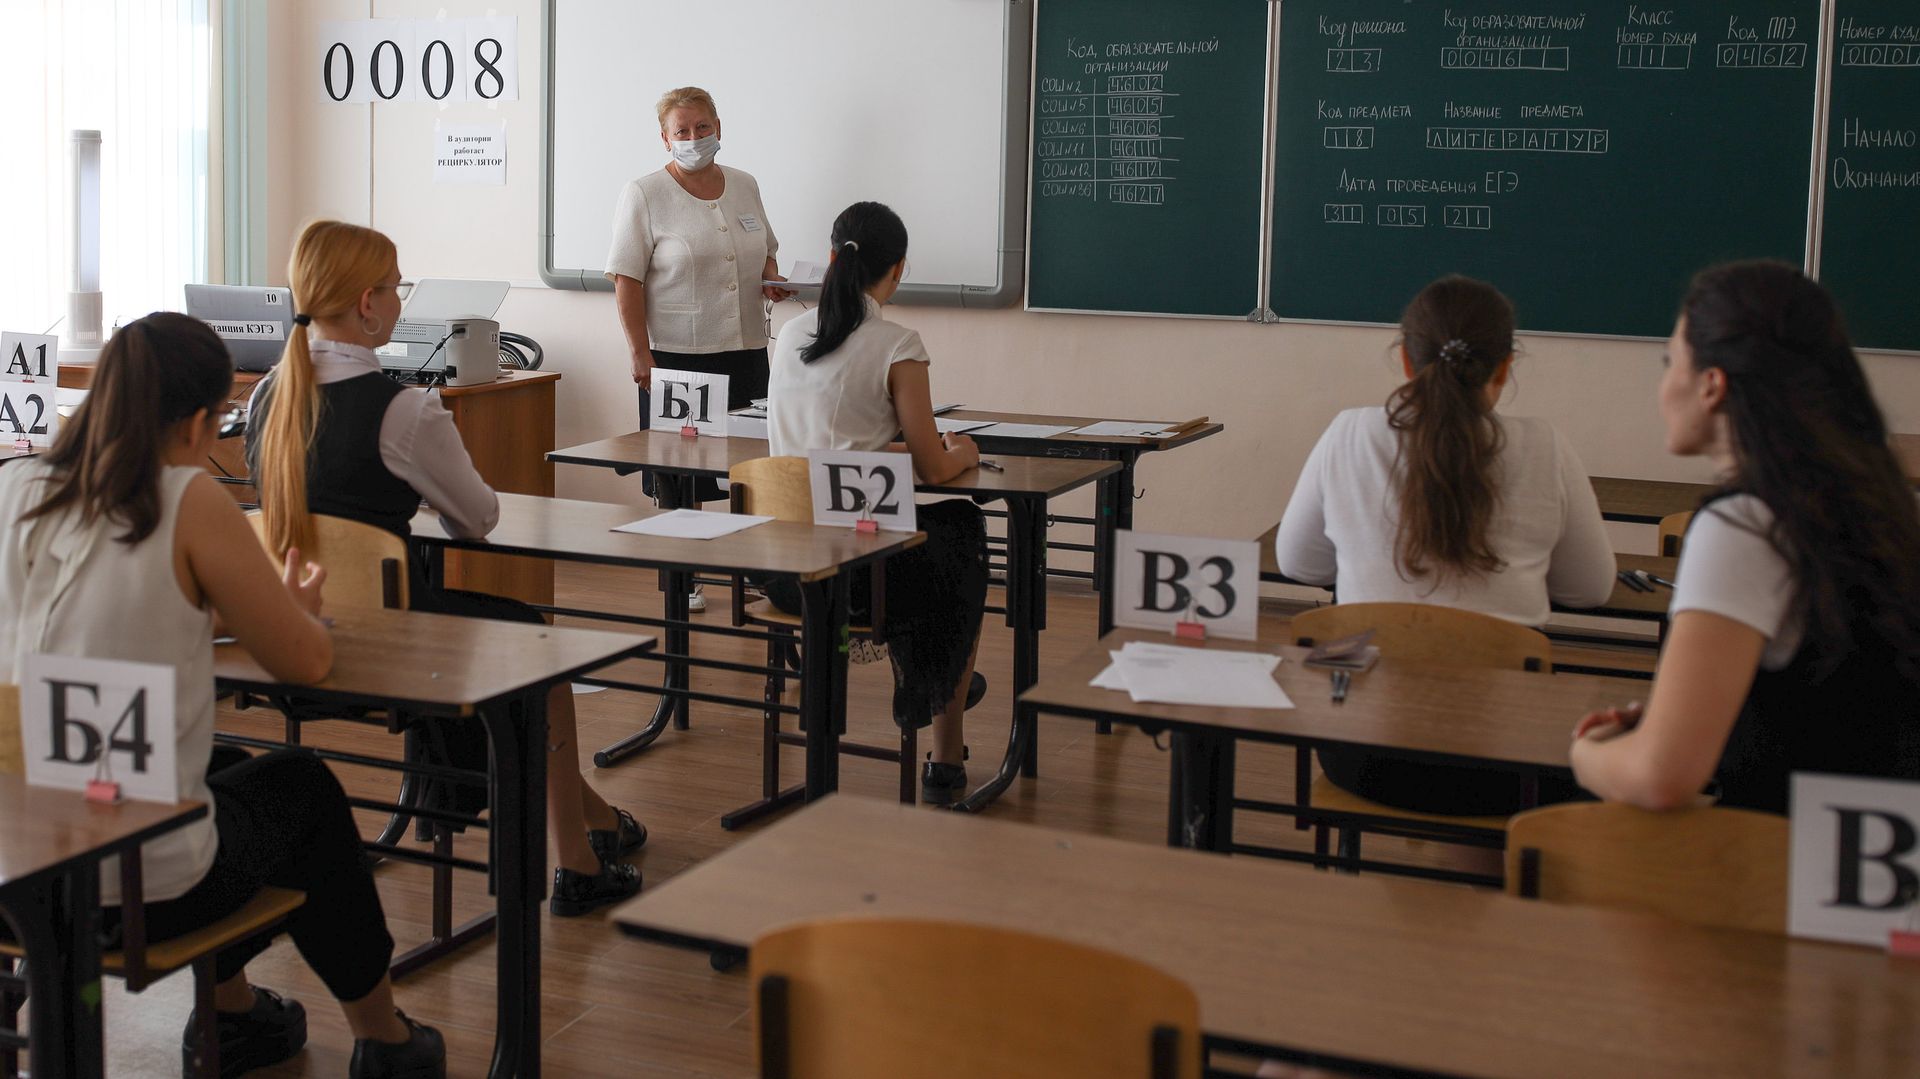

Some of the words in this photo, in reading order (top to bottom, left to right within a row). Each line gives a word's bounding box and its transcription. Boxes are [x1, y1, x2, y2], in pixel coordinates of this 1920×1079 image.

[1319, 15, 1346, 47] Код
[1350, 20, 1407, 46] региона
[1767, 16, 1796, 40] ППЭ
[1336, 51, 1372, 71] 23
[1447, 50, 1515, 67] 0046
[1723, 47, 1797, 65] 0462
[1849, 46, 1920, 65] 000
[1085, 61, 1169, 74] ОРГАНИЗАЦИИ
[1349, 105, 1412, 120] ПРЕДМЕТА
[1521, 104, 1584, 118] ПРЕДМЕТА
[454, 136, 492, 144] аудитории
[453, 146, 484, 156] работает
[437, 159, 503, 167] РЕЦИРКУЛЯТОР
[1485, 171, 1519, 194] ЕГЭ
[266, 293, 277, 303] 10
[207, 323, 244, 333] танция
[246, 324, 274, 334] КЭГЭ
[6, 341, 49, 378] А1
[658, 379, 712, 423] Б1
[0, 392, 48, 435] А2
[822, 463, 899, 515] Б2
[1134, 548, 1237, 619] В3
[40, 676, 154, 774] Б4
[1823, 803, 1920, 914] В
